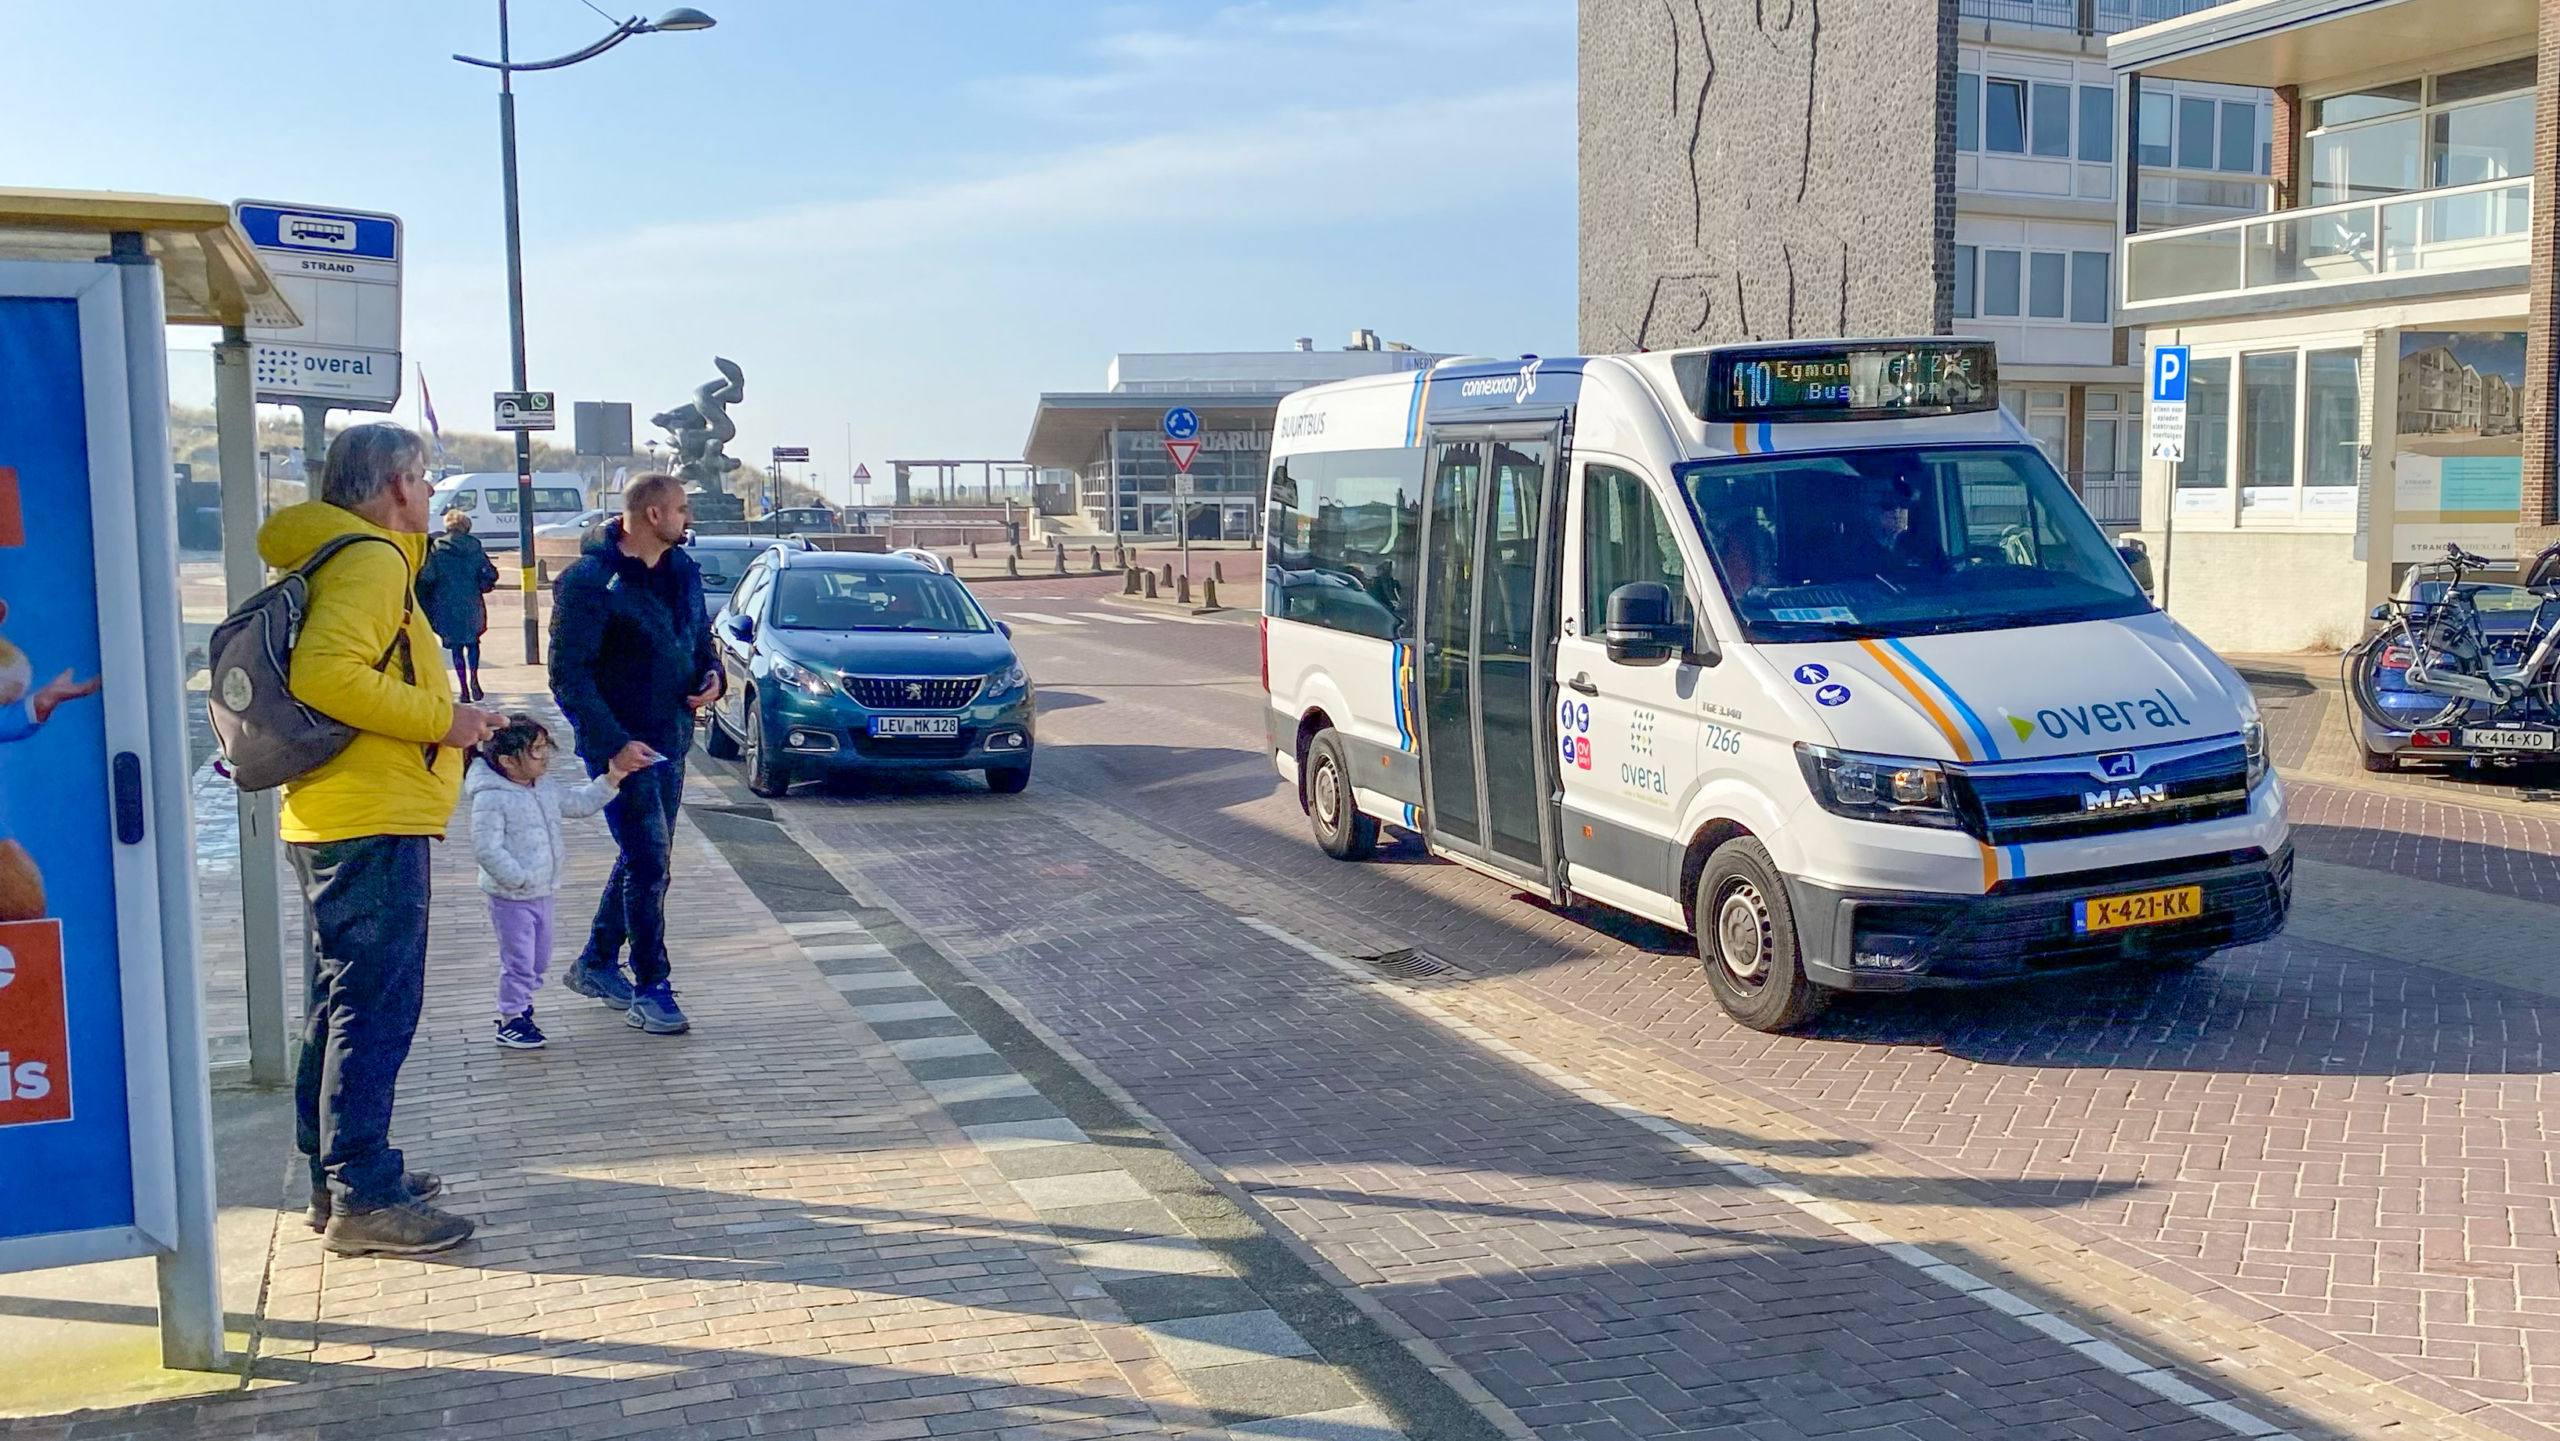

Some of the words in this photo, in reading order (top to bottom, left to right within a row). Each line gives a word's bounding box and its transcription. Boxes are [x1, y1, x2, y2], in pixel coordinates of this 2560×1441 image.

[301, 260, 355, 273] STRAND
[304, 356, 373, 375] overal
[2160, 353, 2180, 396] P
[1461, 379, 1518, 397] connexxion
[1733, 361, 1771, 407] 410
[1281, 411, 1327, 439] BUURTBUS
[880, 719, 905, 732] LEV
[914, 719, 930, 732] MK
[933, 719, 956, 732] 128
[2036, 688, 2191, 739] overal
[1577, 741, 1591, 756] OV
[1705, 724, 1742, 755] 7266
[2474, 731, 2543, 747] K-414-XD
[1621, 762, 1669, 796] overal
[2084, 783, 2166, 811] MAN
[2097, 891, 2191, 926] X-421-KK
